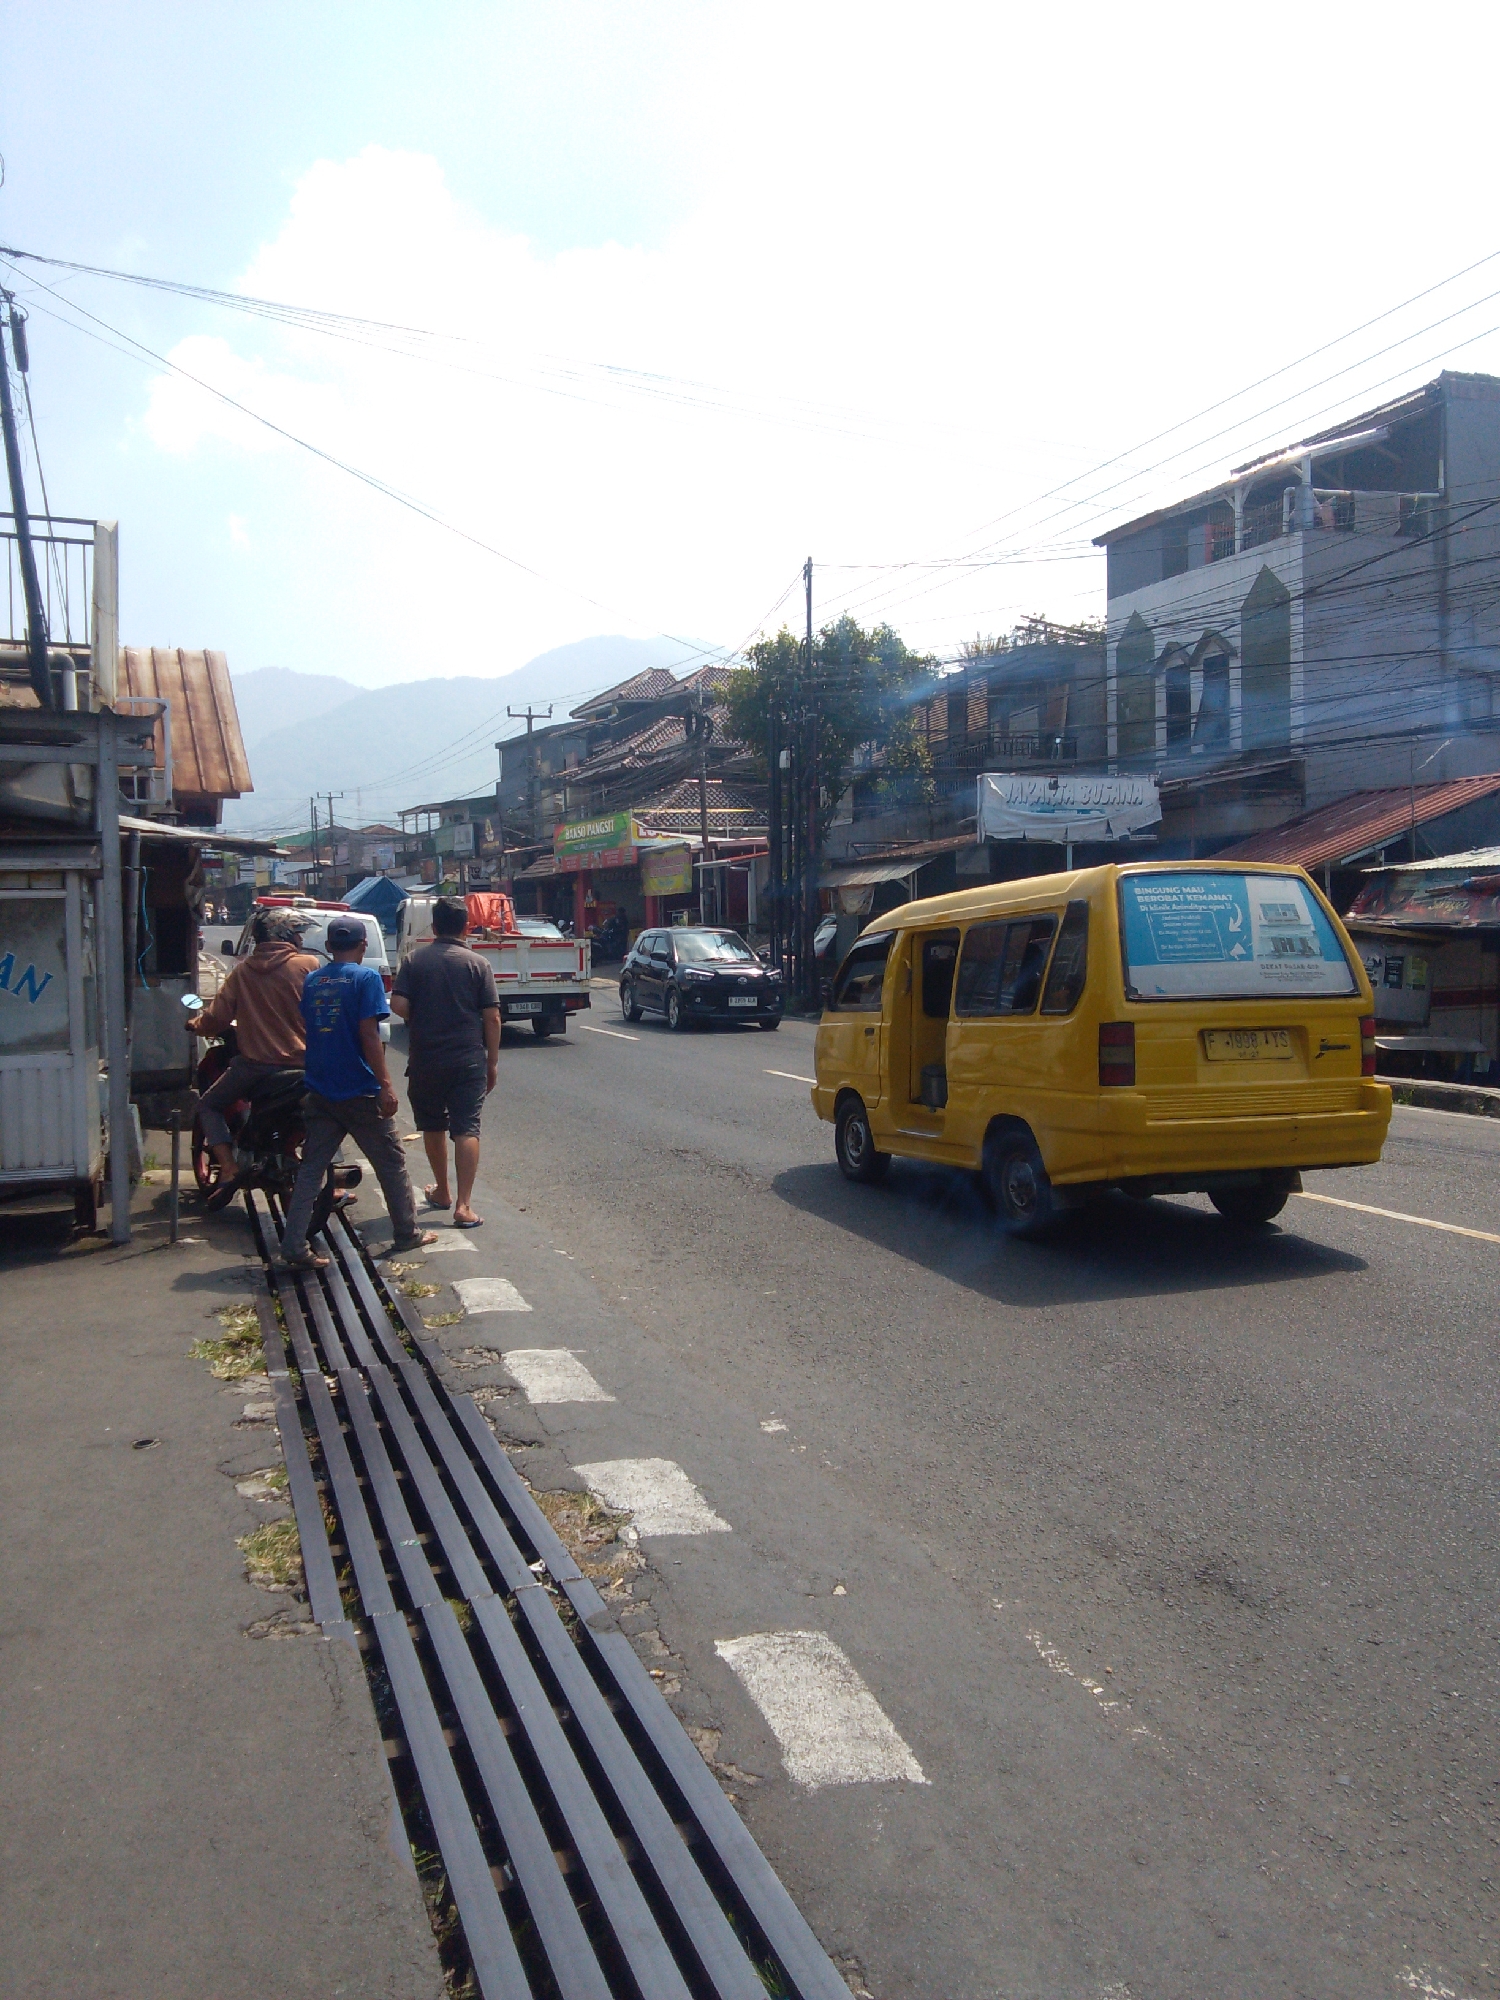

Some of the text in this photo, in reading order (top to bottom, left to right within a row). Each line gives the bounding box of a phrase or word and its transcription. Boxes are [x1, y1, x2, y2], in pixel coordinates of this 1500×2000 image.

[565, 820, 615, 840] BAKSO PANGSIT
[1134, 886, 1205, 895] BINGUNG MAU
[1137, 894, 1184, 903] BEROBAT
[1207, 1032, 1215, 1049] F
